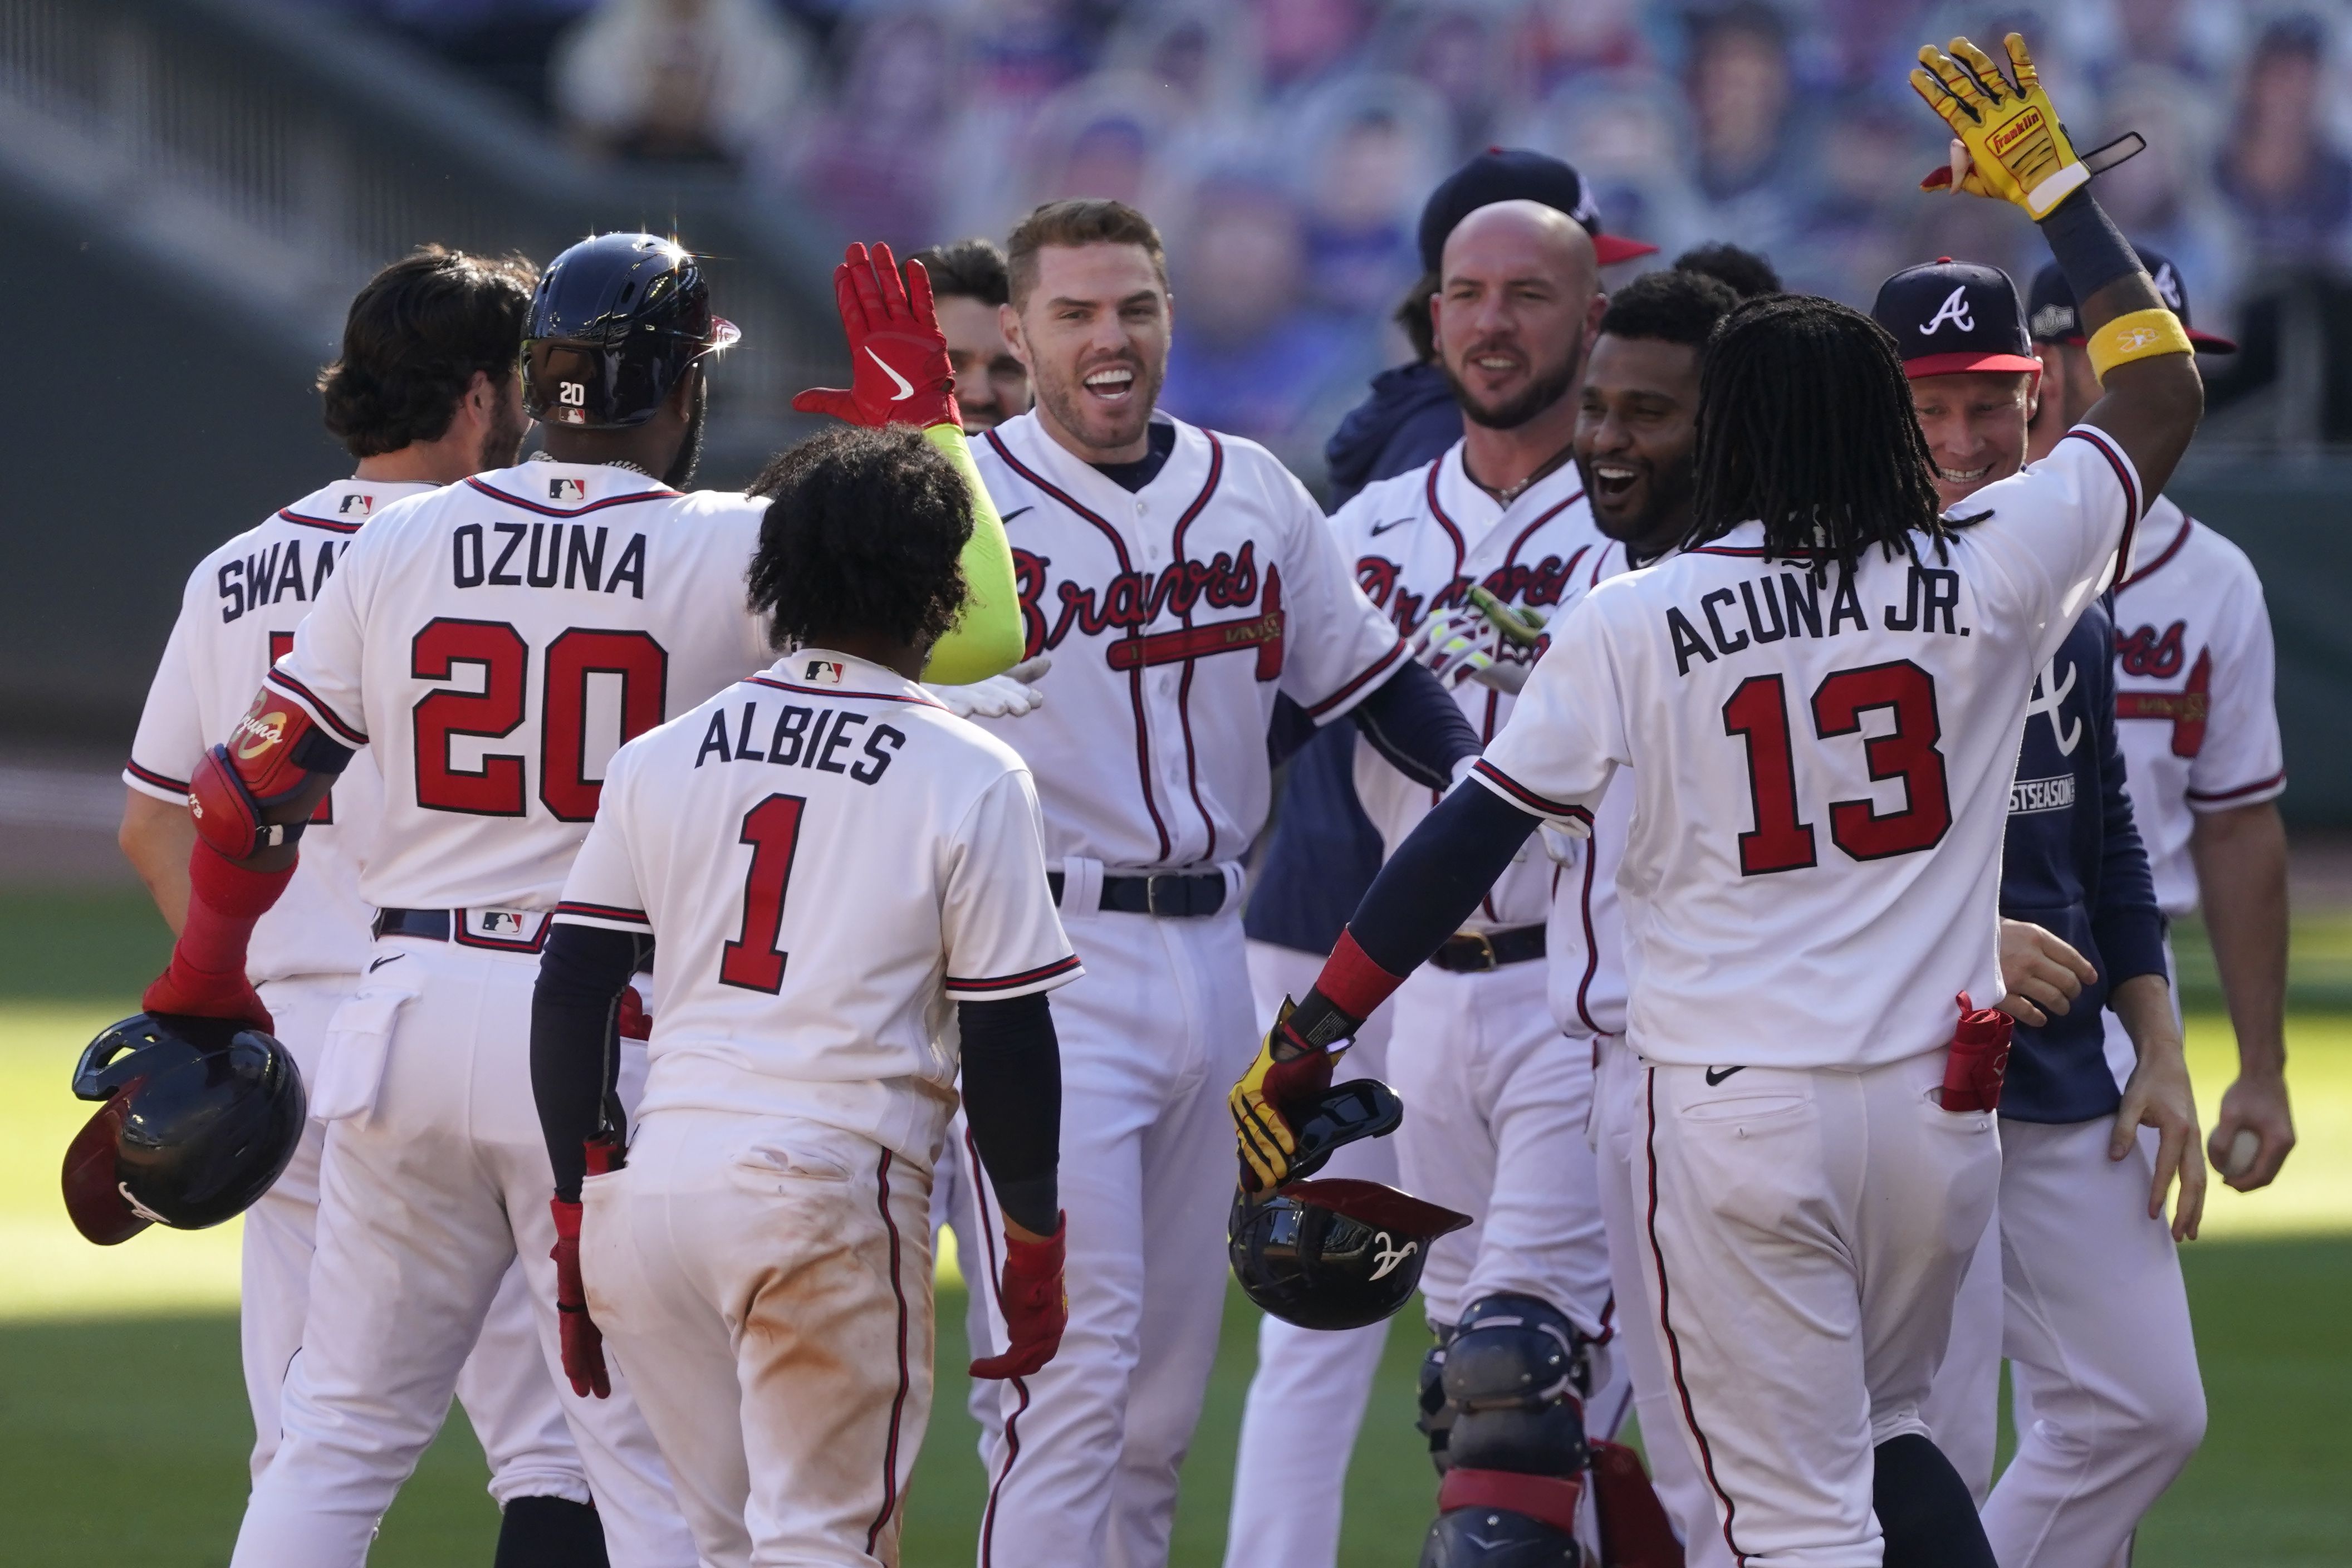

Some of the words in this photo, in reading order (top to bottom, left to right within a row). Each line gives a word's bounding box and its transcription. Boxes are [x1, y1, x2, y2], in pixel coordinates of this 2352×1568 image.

[1993, 113, 2040, 154] Franklin
[1919, 285, 1975, 335] A
[560, 381, 585, 406] 20
[452, 521, 647, 600] OZUNA
[1665, 559, 1868, 677] ACUÑA
[1884, 567, 1971, 638] JR.
[411, 616, 669, 822] 20
[694, 701, 906, 786] ALBIES
[1721, 658, 1953, 877] 13
[718, 792, 807, 996] 1
